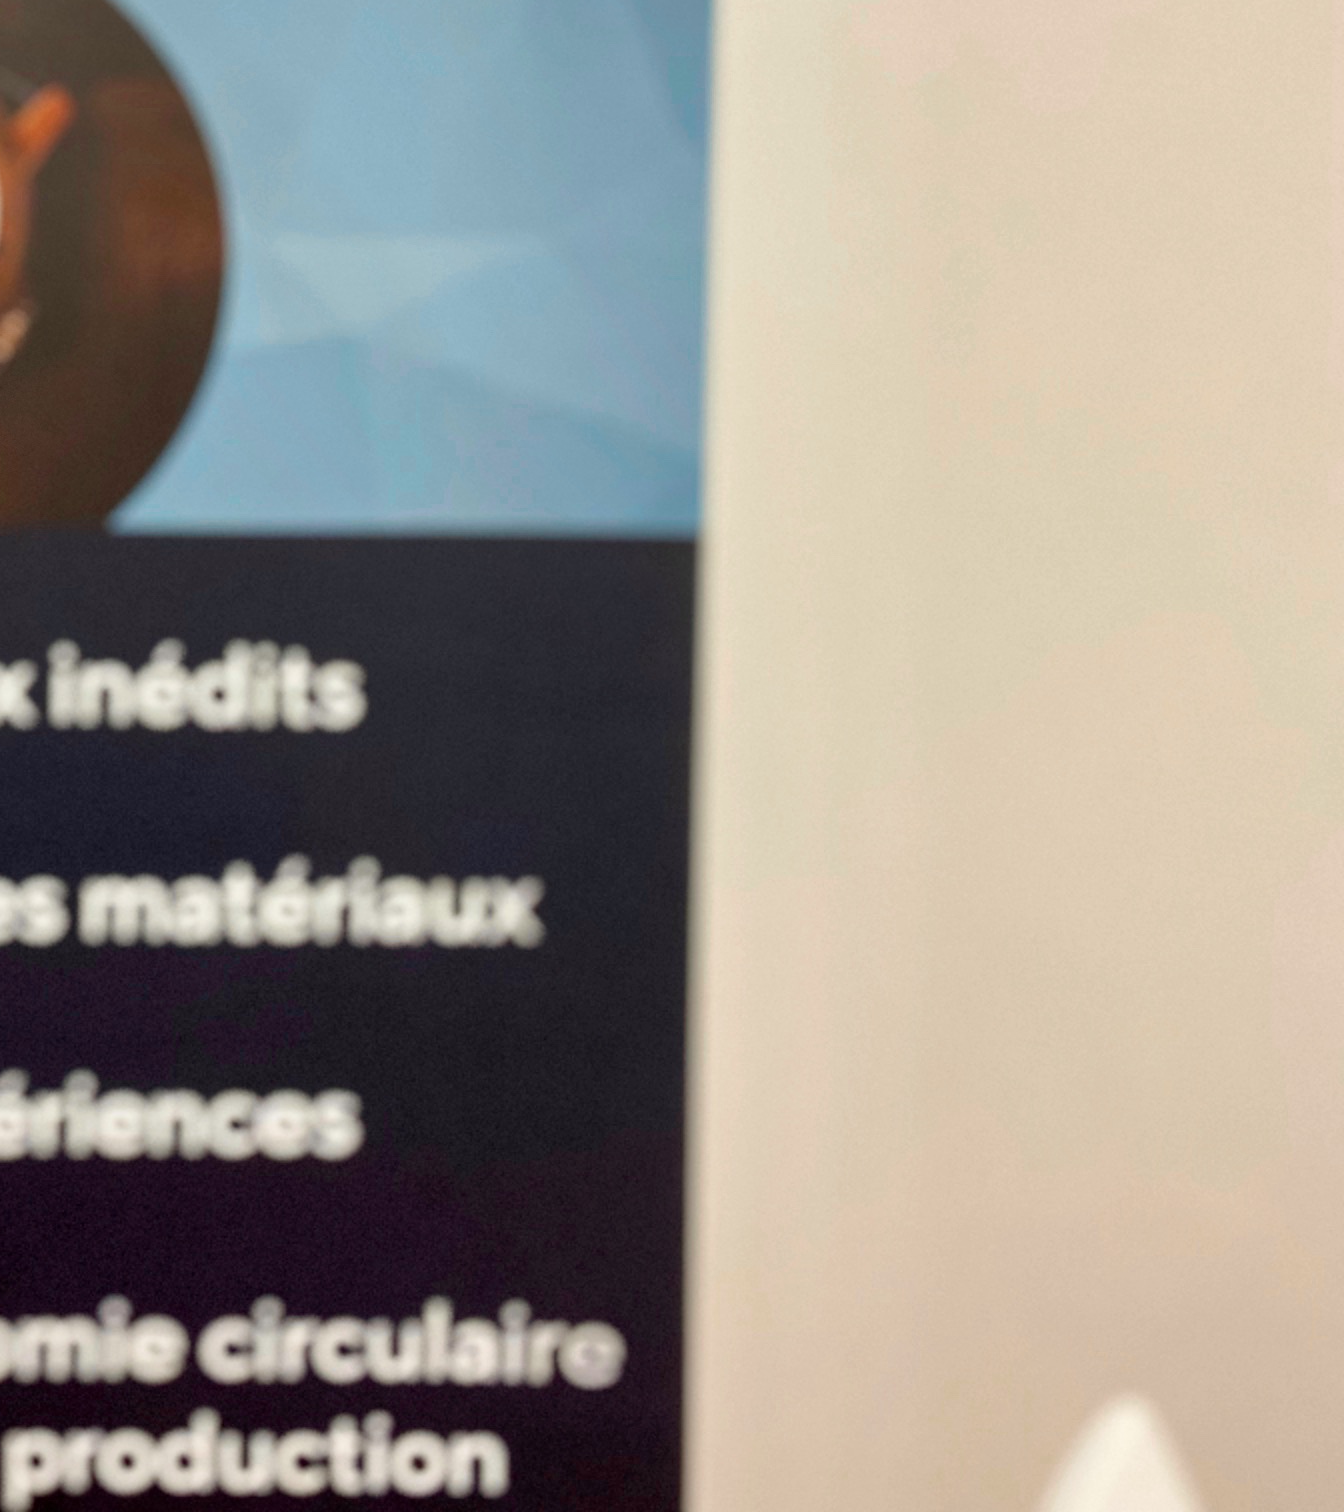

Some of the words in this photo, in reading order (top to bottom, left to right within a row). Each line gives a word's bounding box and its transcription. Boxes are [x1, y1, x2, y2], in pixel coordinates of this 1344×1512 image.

[46, 638, 366, 733] inédits
[78, 853, 546, 948] matériaux
[196, 1295, 627, 1389] circulaire
[0, 1406, 510, 1512] production
